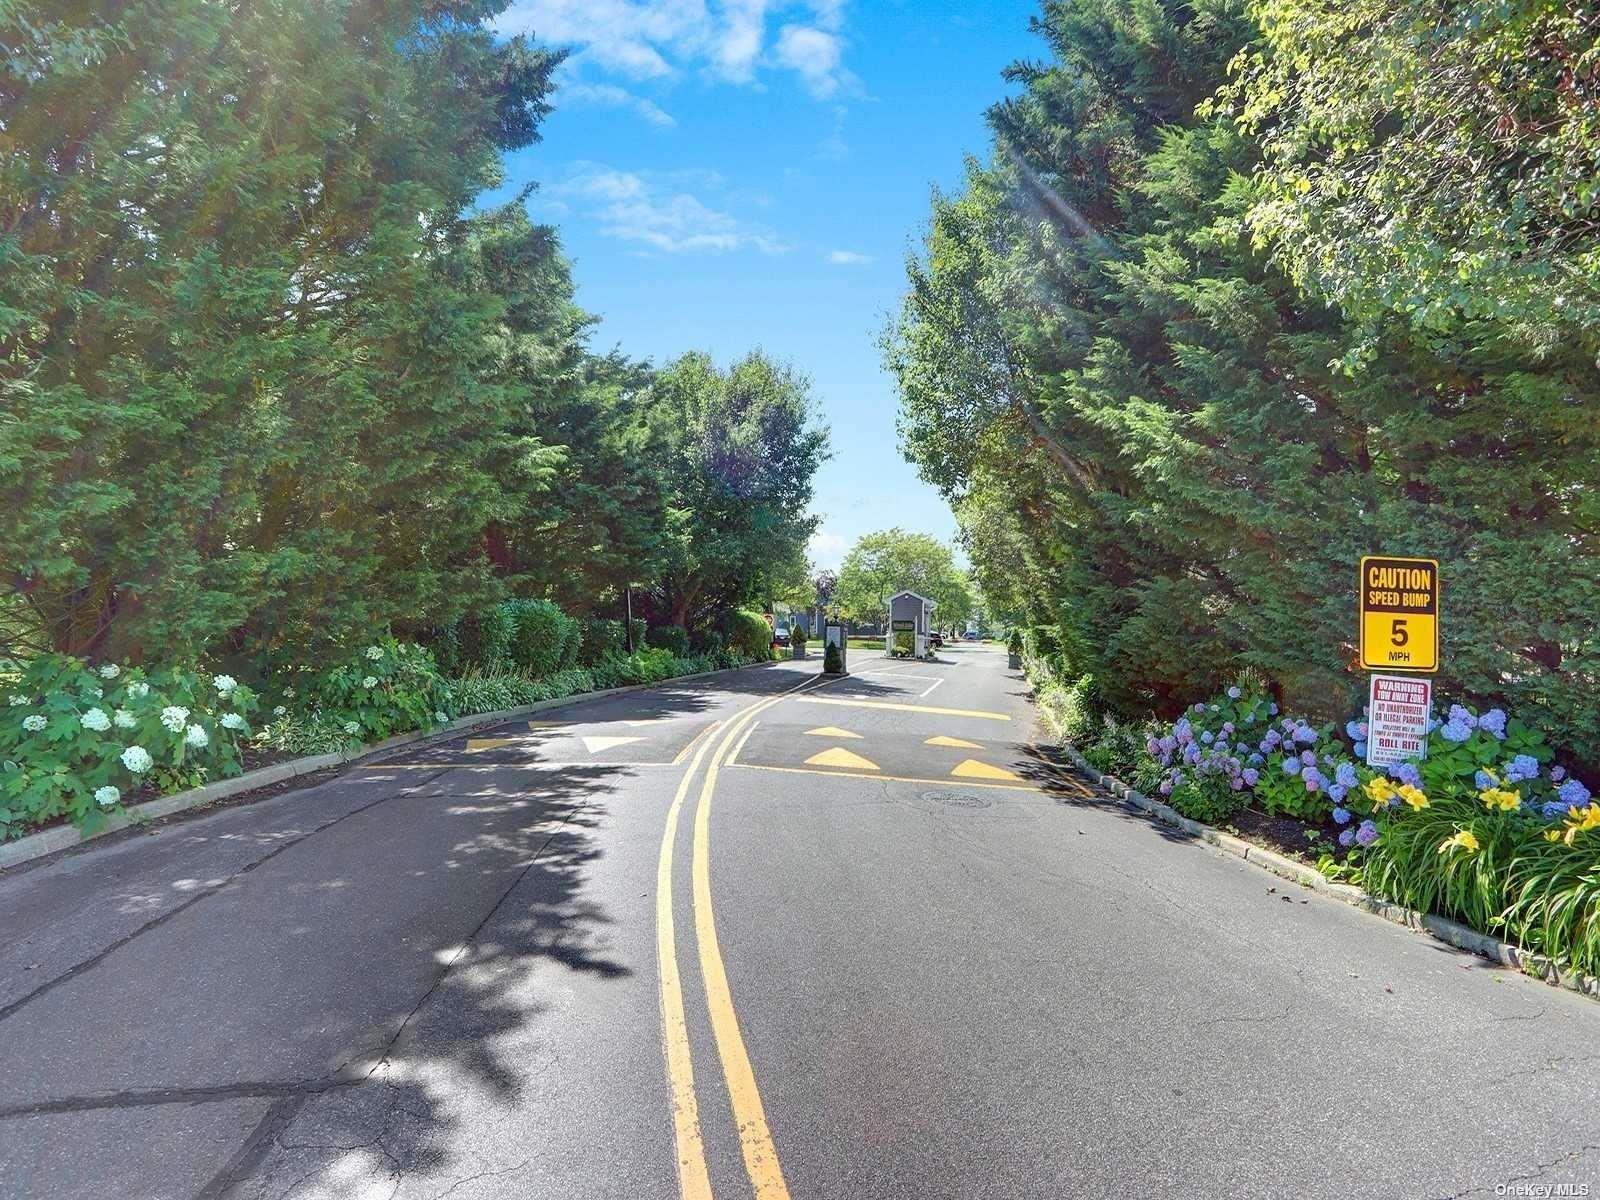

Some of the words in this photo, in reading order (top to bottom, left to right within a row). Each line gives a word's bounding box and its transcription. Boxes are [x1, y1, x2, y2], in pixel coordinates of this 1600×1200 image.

[1369, 567, 1430, 590] CAUTION
[1369, 591, 1400, 606] SPEED
[1402, 593, 1431, 607] BUMP
[1391, 619, 1409, 647] 5
[1388, 651, 1410, 662] MPH
[1378, 681, 1424, 693] WARNING
[1377, 690, 1391, 700] TOW
[1391, 692, 1409, 703] AWAY
[1409, 694, 1425, 704] ZONE
[1402, 715, 1424, 725] PARKING
[1379, 738, 1398, 748] ROLL
[1402, 740, 1419, 750] RITE
